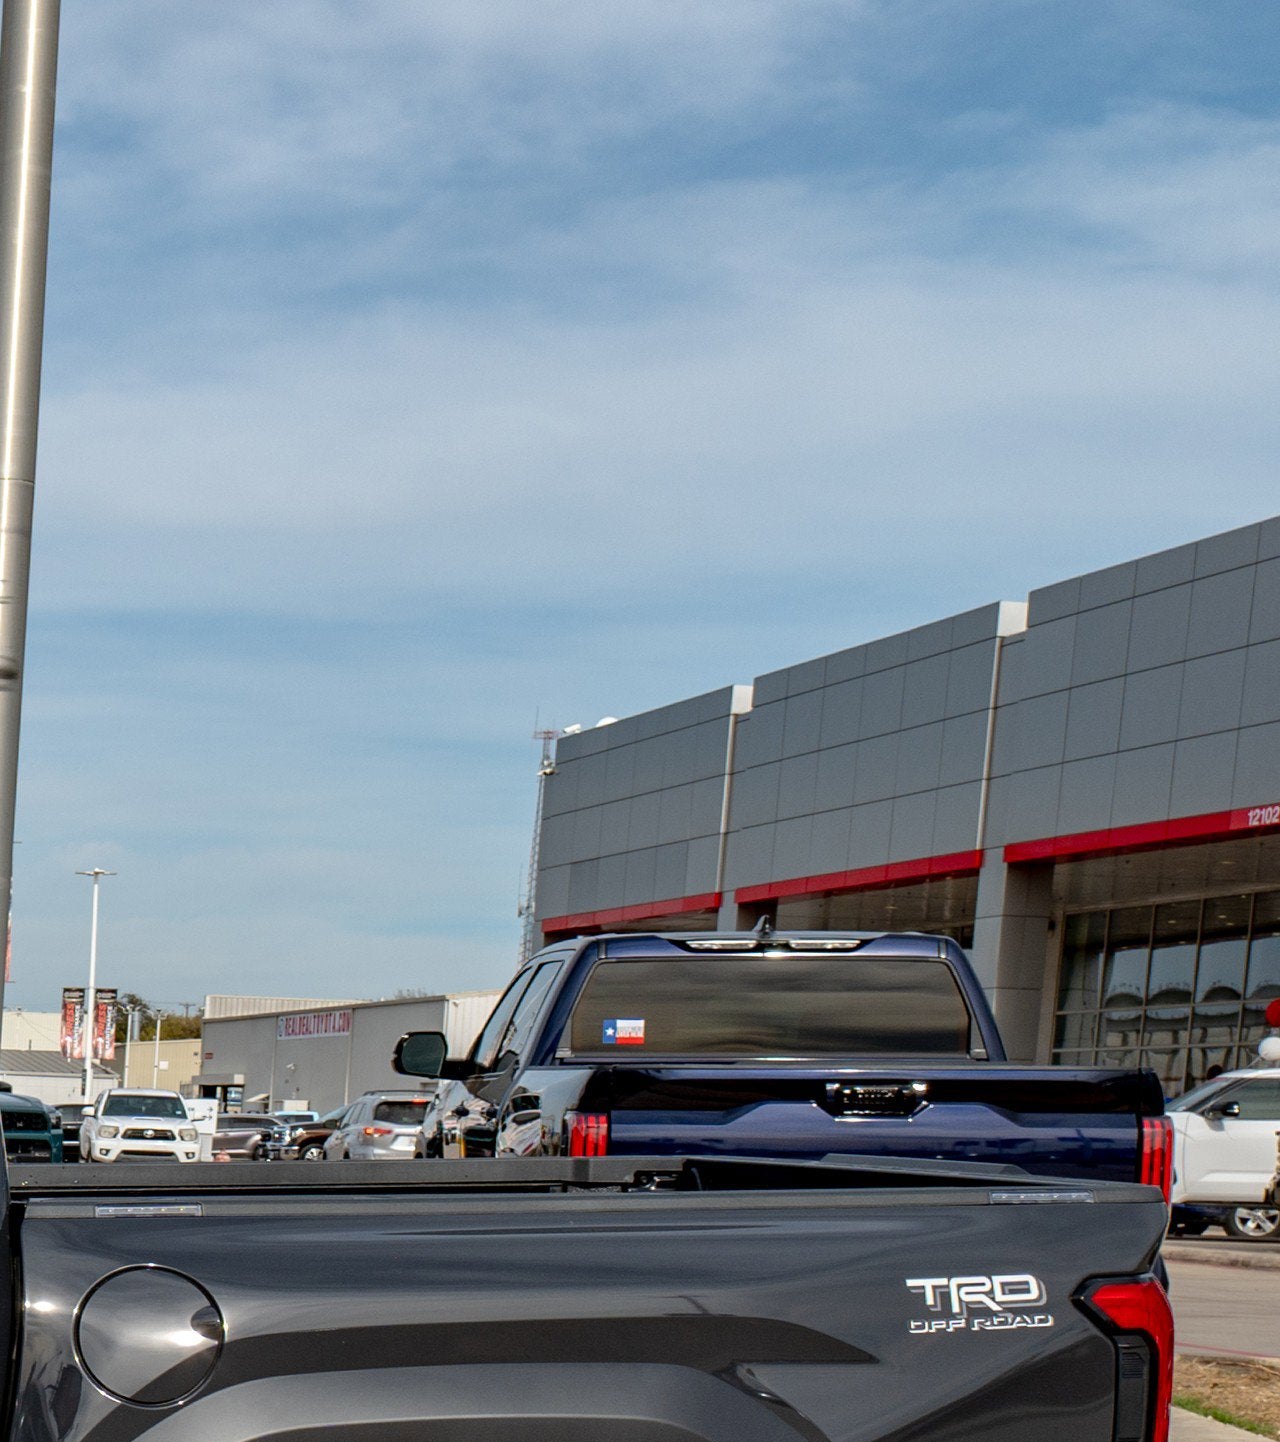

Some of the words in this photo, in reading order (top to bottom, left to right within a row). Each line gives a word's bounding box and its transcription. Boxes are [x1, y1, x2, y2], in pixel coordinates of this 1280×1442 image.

[1248, 805, 1280, 827] 12102
[906, 1274, 1047, 1317] TRD
[909, 1318, 966, 1333] OFF
[971, 1313, 1054, 1330] ROAD
